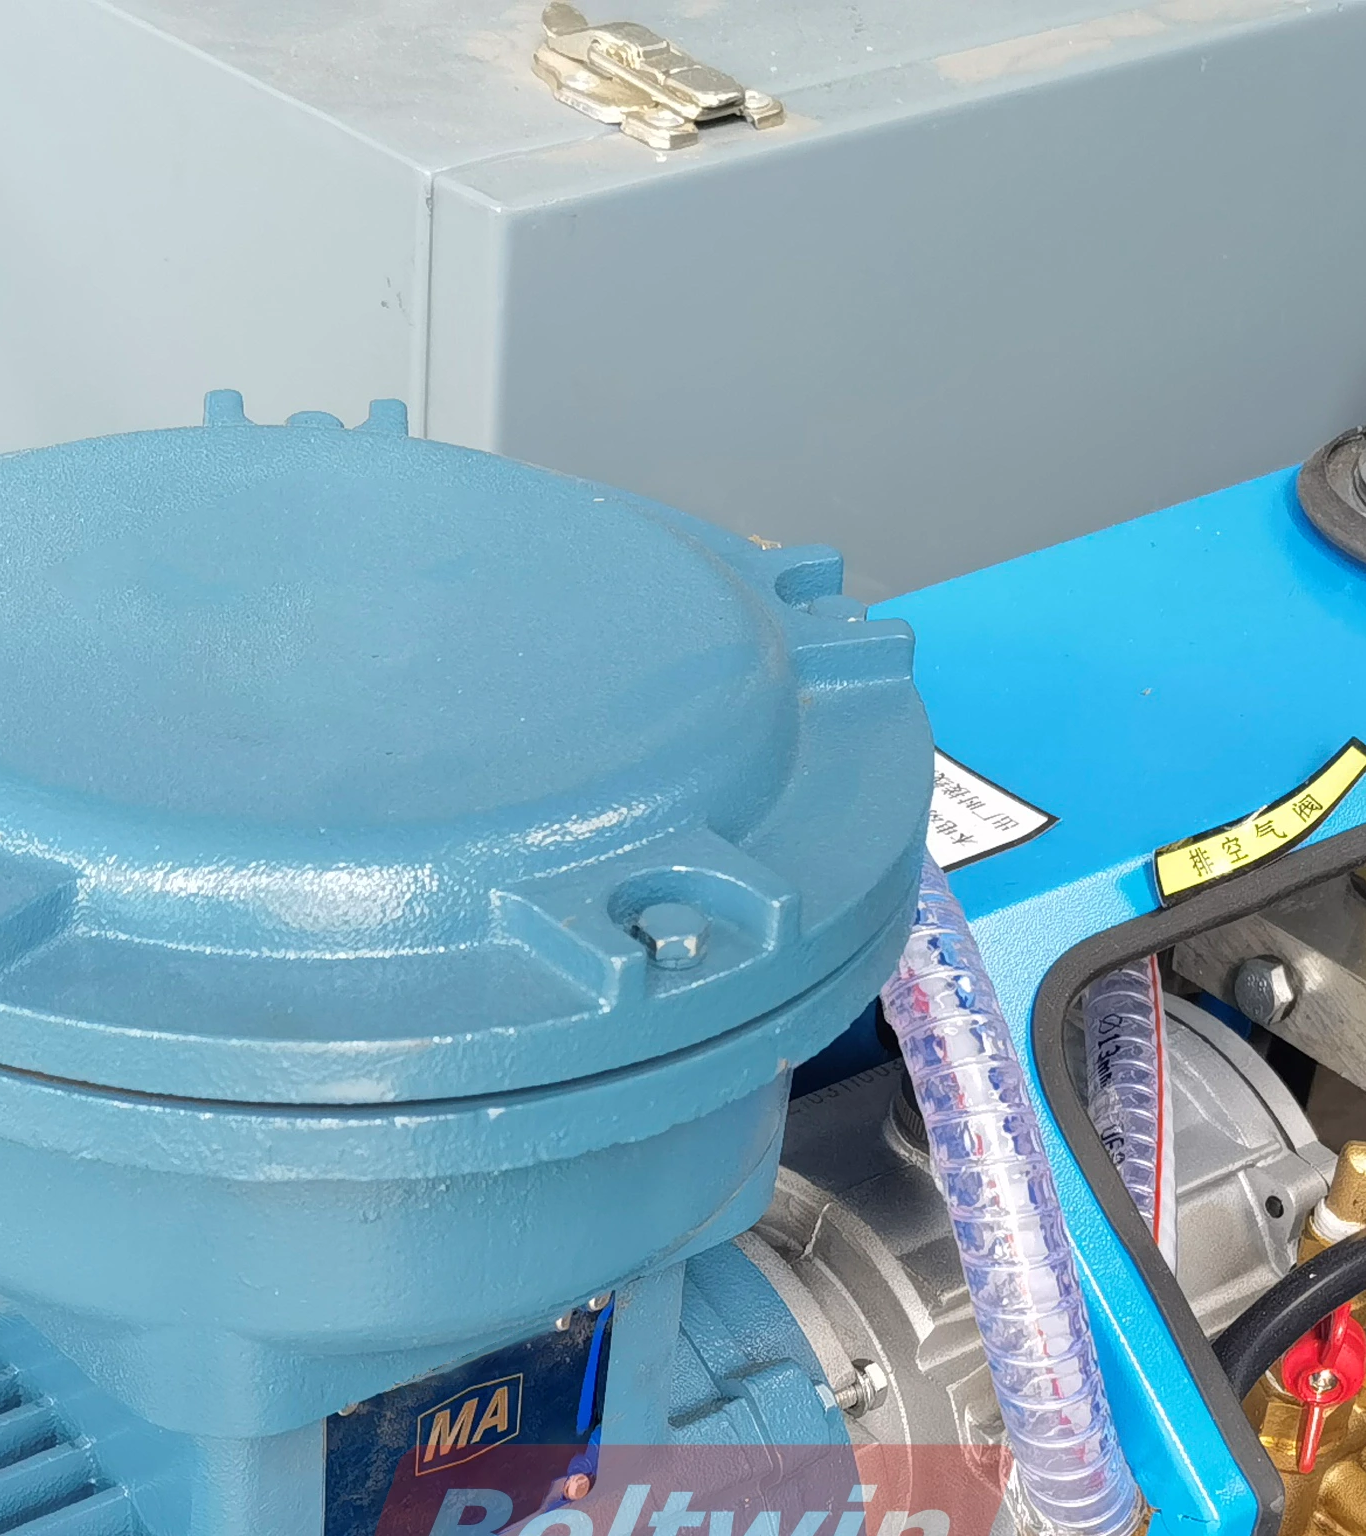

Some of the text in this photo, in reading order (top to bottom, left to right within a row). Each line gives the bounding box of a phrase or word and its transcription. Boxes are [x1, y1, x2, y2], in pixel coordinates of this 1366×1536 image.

[933, 769, 1020, 832] 出厂时接线
[1188, 793, 1324, 877] 排空气阀
[422, 1385, 509, 1463] MA
